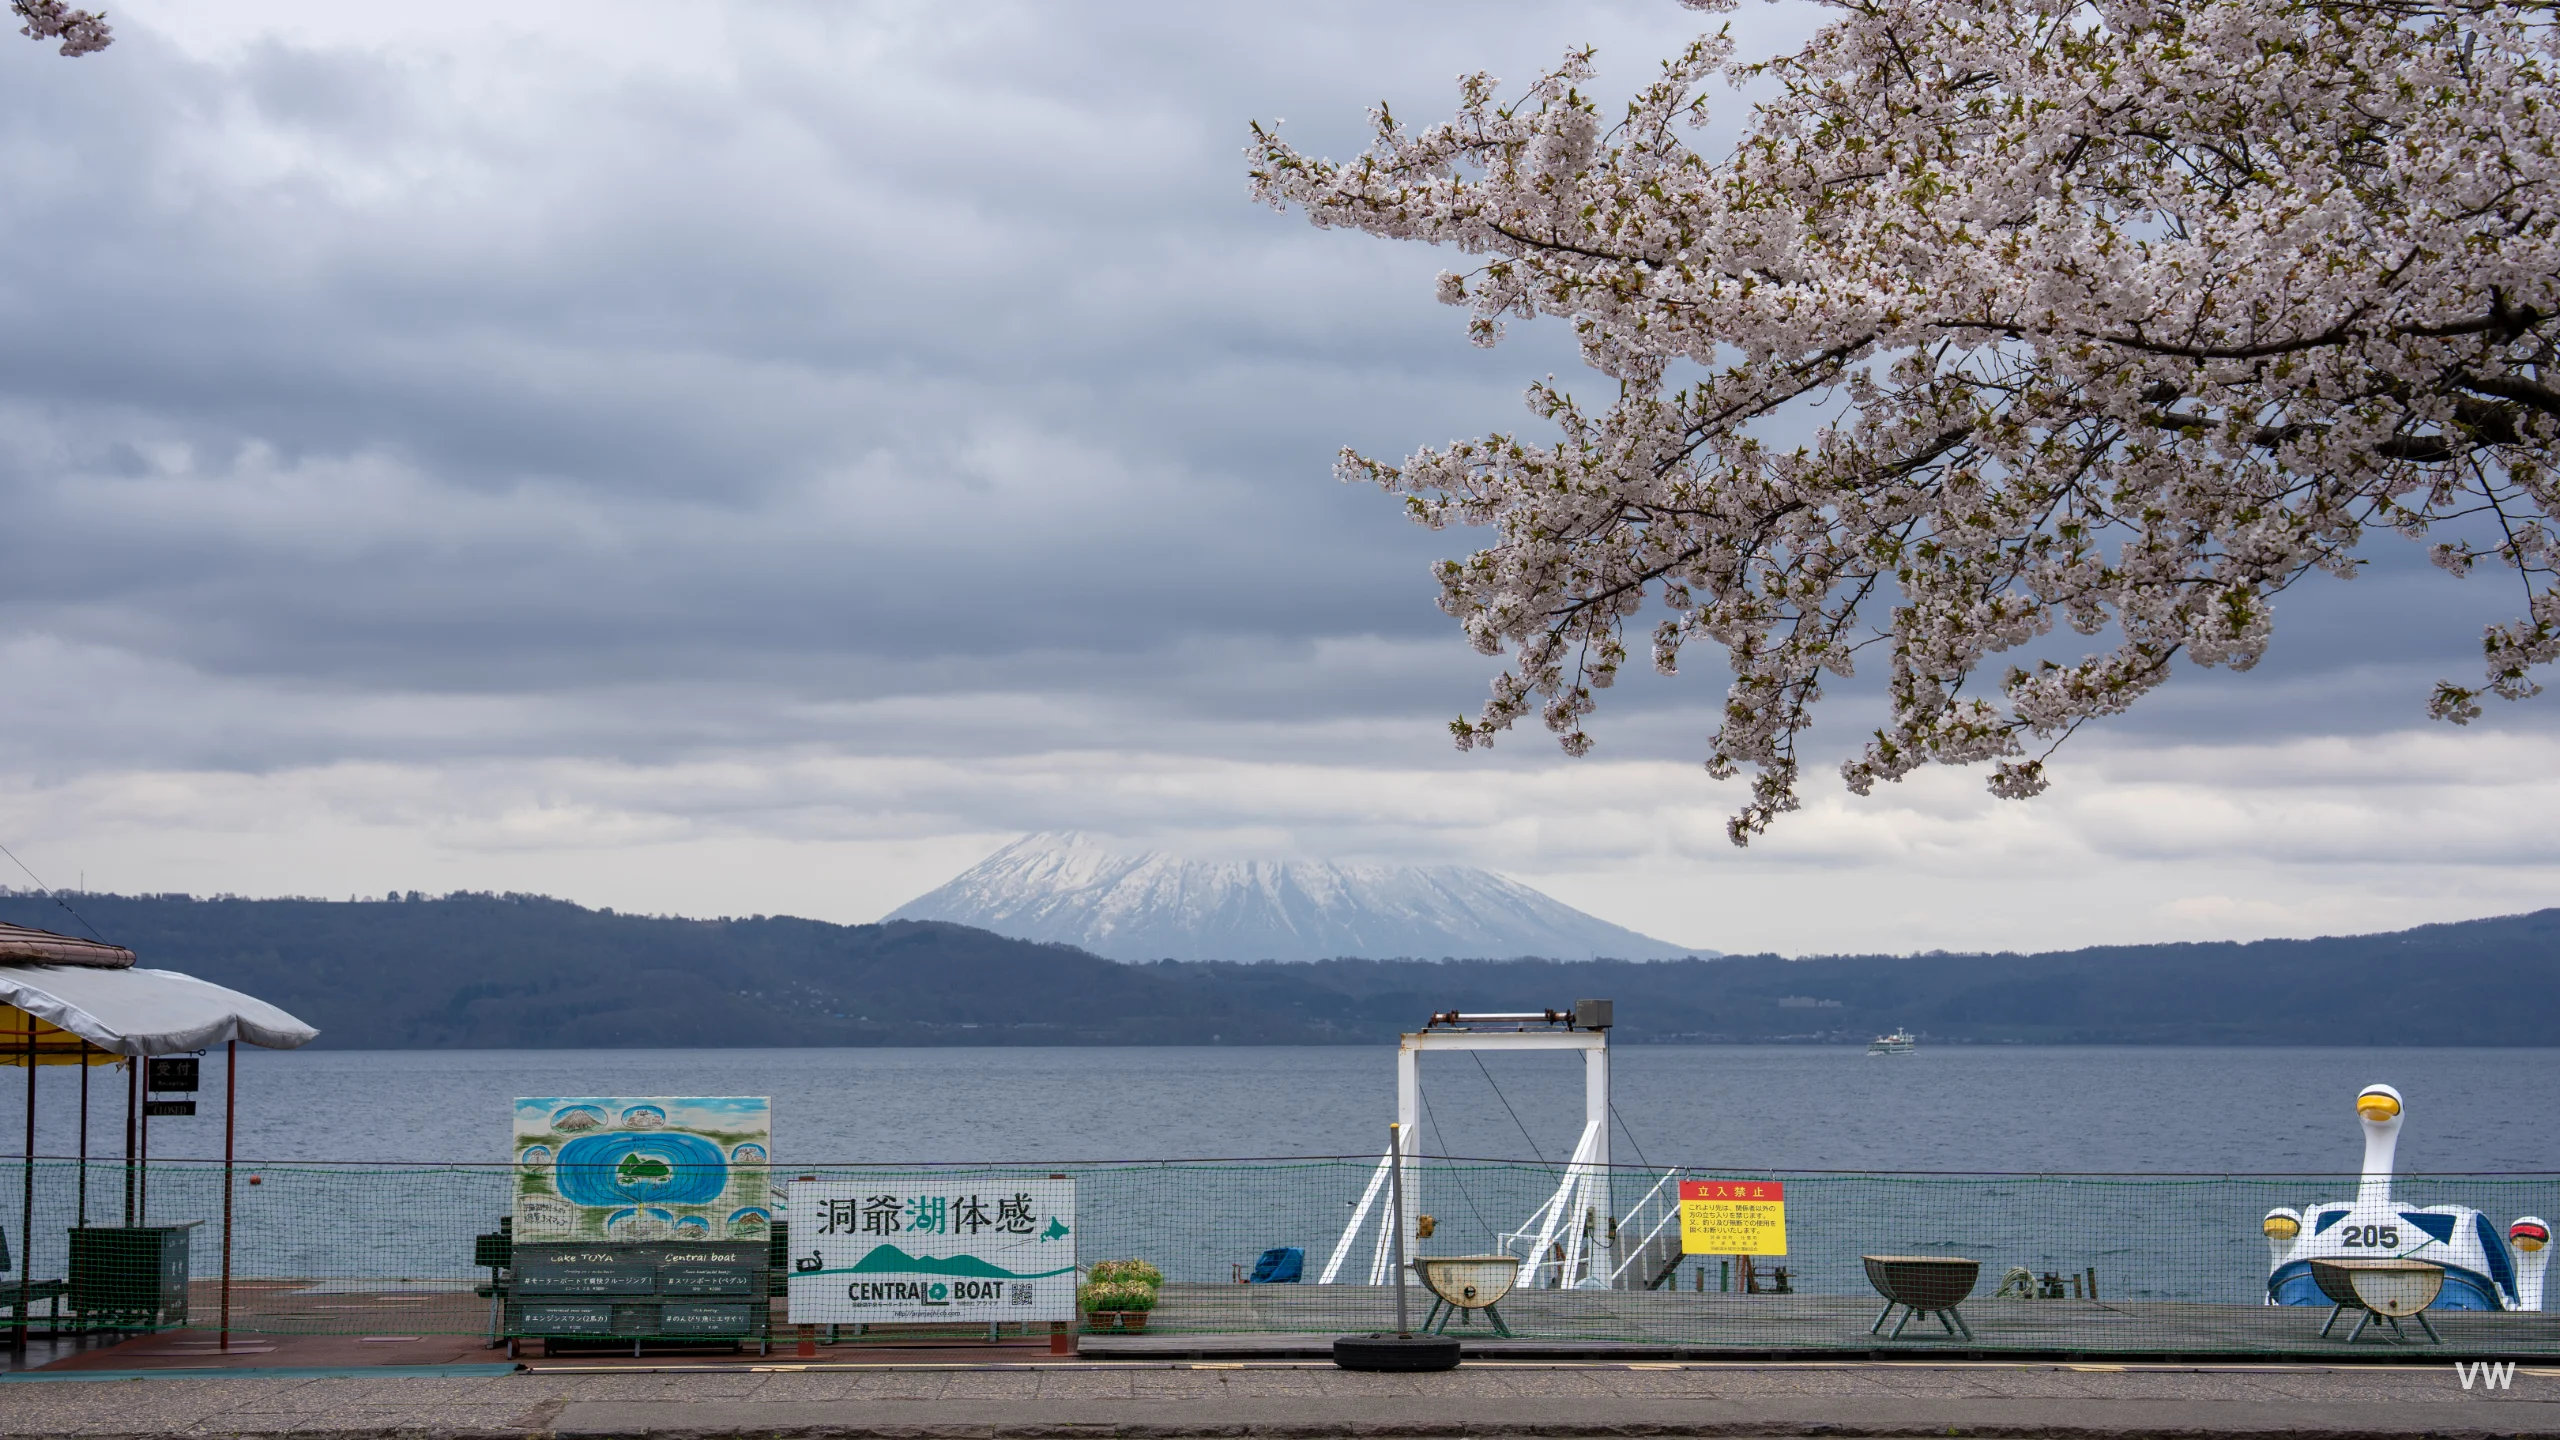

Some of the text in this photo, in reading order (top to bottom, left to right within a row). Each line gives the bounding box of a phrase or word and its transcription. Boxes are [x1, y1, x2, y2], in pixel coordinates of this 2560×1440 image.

[157, 1062, 190, 1076] 受付
[153, 1104, 187, 1115] CLOSED
[1698, 1186, 1765, 1198] 立入禁止
[816, 1192, 1037, 1236] 洞爺湖体感
[2341, 1224, 2400, 1249] 205
[580, 1253, 614, 1262] TOYA
[664, 1252, 737, 1262] Central boat
[849, 1282, 949, 1306] CENTRAL
[954, 1280, 1004, 1299] BOAT
